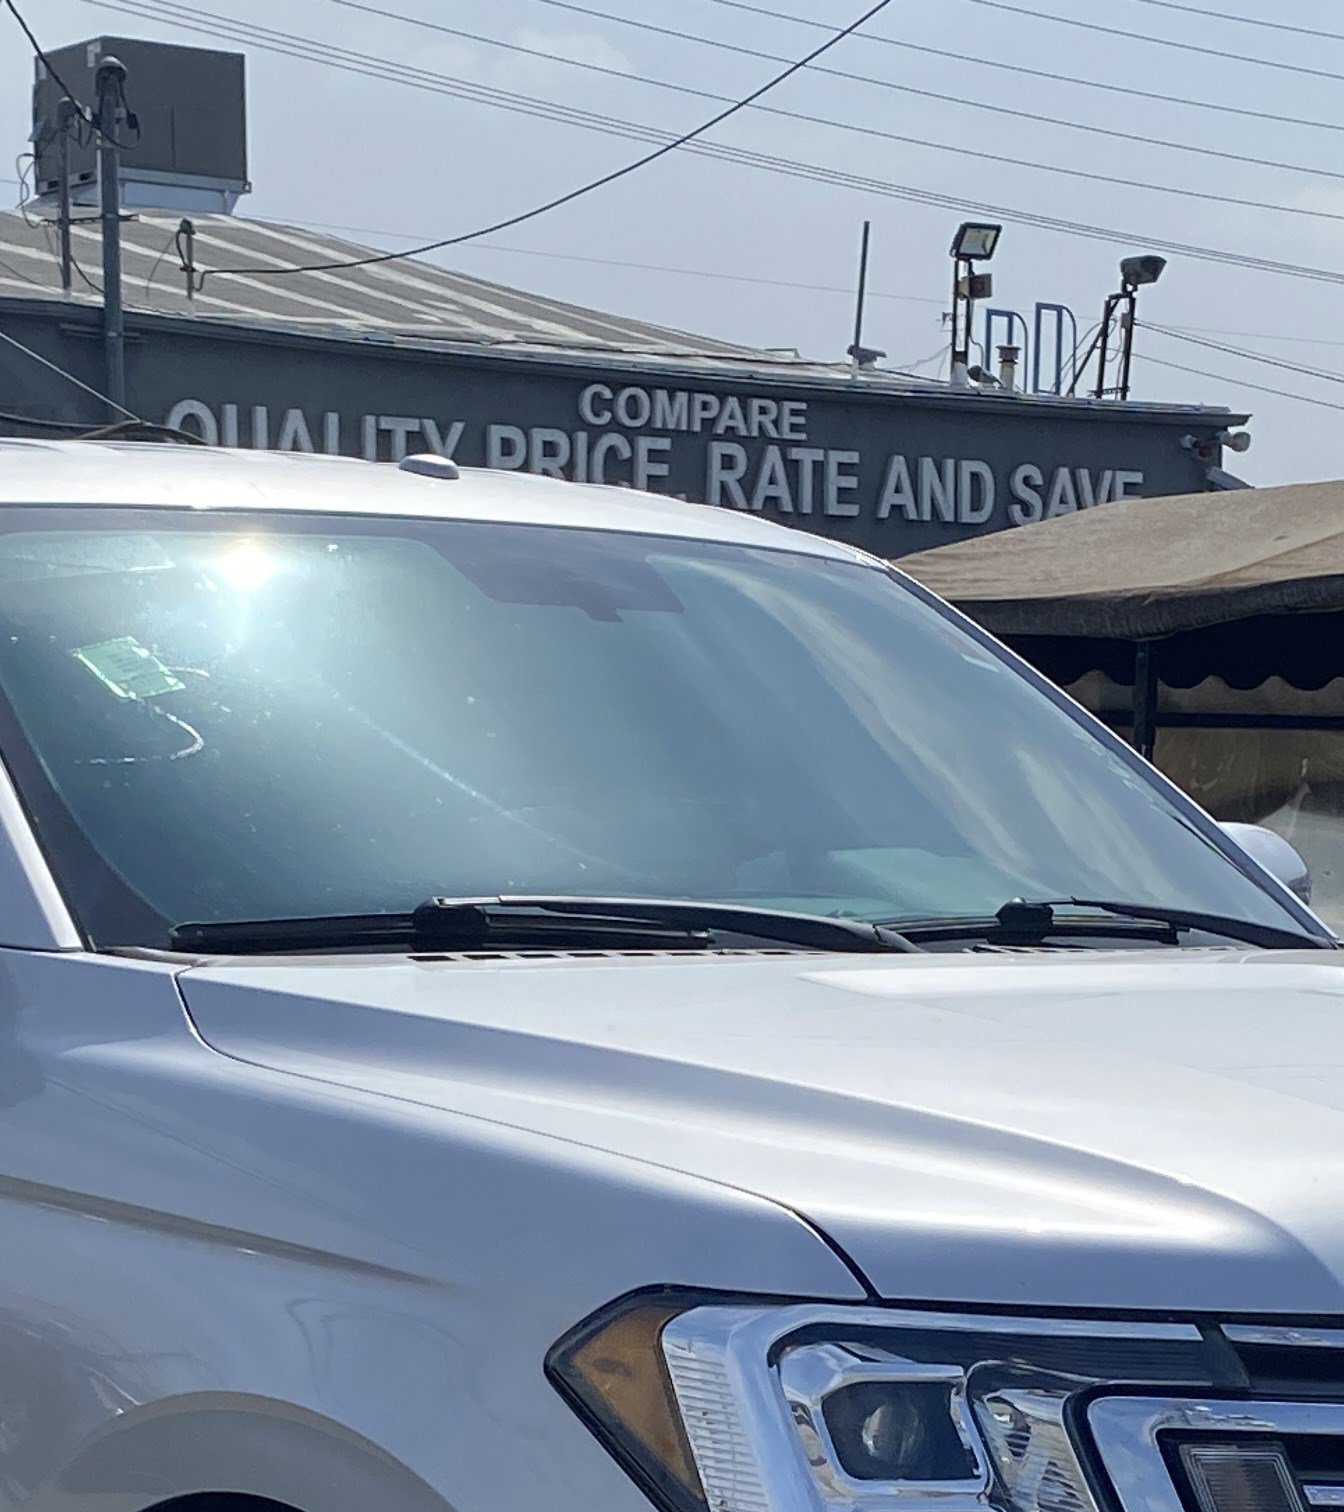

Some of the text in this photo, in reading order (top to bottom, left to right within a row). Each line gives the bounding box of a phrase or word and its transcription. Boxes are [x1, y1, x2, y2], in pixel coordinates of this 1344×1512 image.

[579, 384, 807, 441] COMPARE
[167, 399, 464, 462] QUALITY
[487, 424, 672, 490] PRICE
[710, 441, 859, 517] RATE
[875, 455, 996, 524] AND
